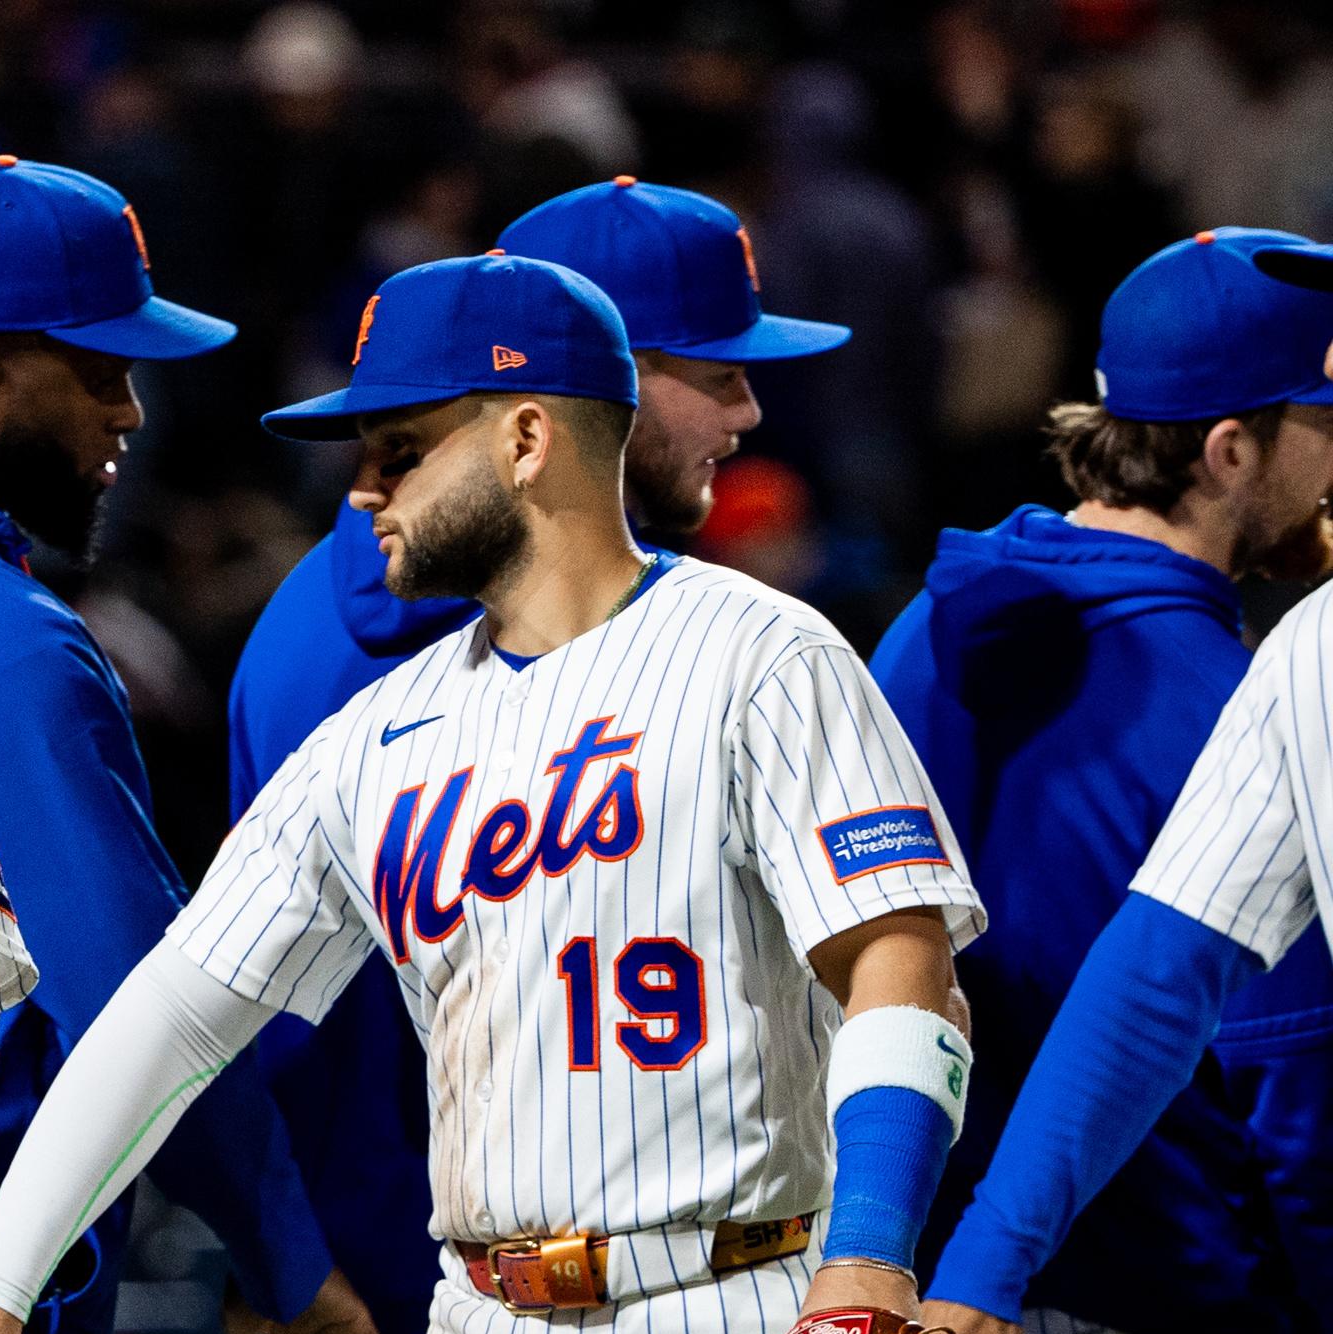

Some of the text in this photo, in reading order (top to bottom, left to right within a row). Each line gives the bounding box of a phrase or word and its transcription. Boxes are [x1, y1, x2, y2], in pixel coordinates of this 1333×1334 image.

[372, 714, 644, 966] Mets
[557, 936, 708, 1072] 19
[551, 1260, 581, 1288] 19
